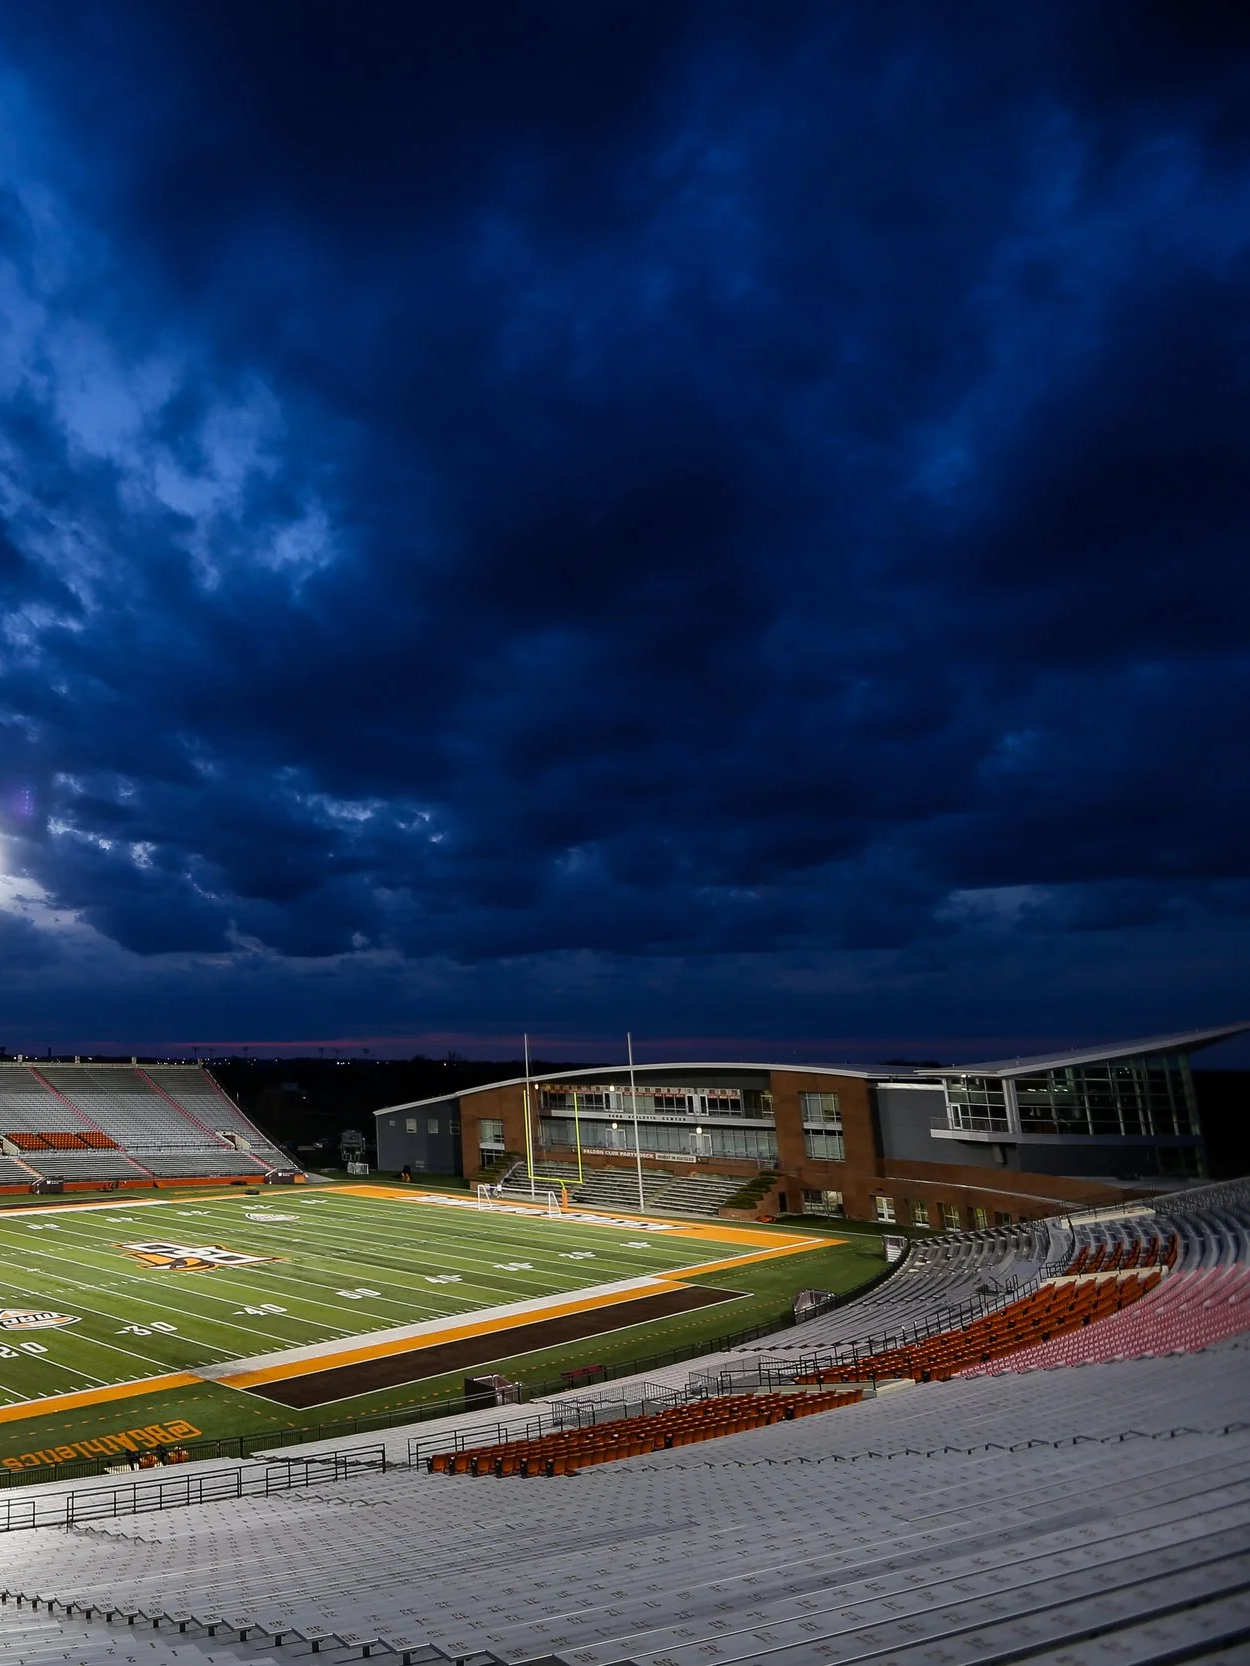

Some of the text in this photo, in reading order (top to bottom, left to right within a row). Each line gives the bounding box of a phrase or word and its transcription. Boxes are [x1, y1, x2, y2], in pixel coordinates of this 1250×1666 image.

[335, 1287, 381, 1300] 50
[243, 1303, 288, 1316] 40
[123, 1321, 178, 1336] 30
[1, 1419, 202, 1472] @BGAthletics
